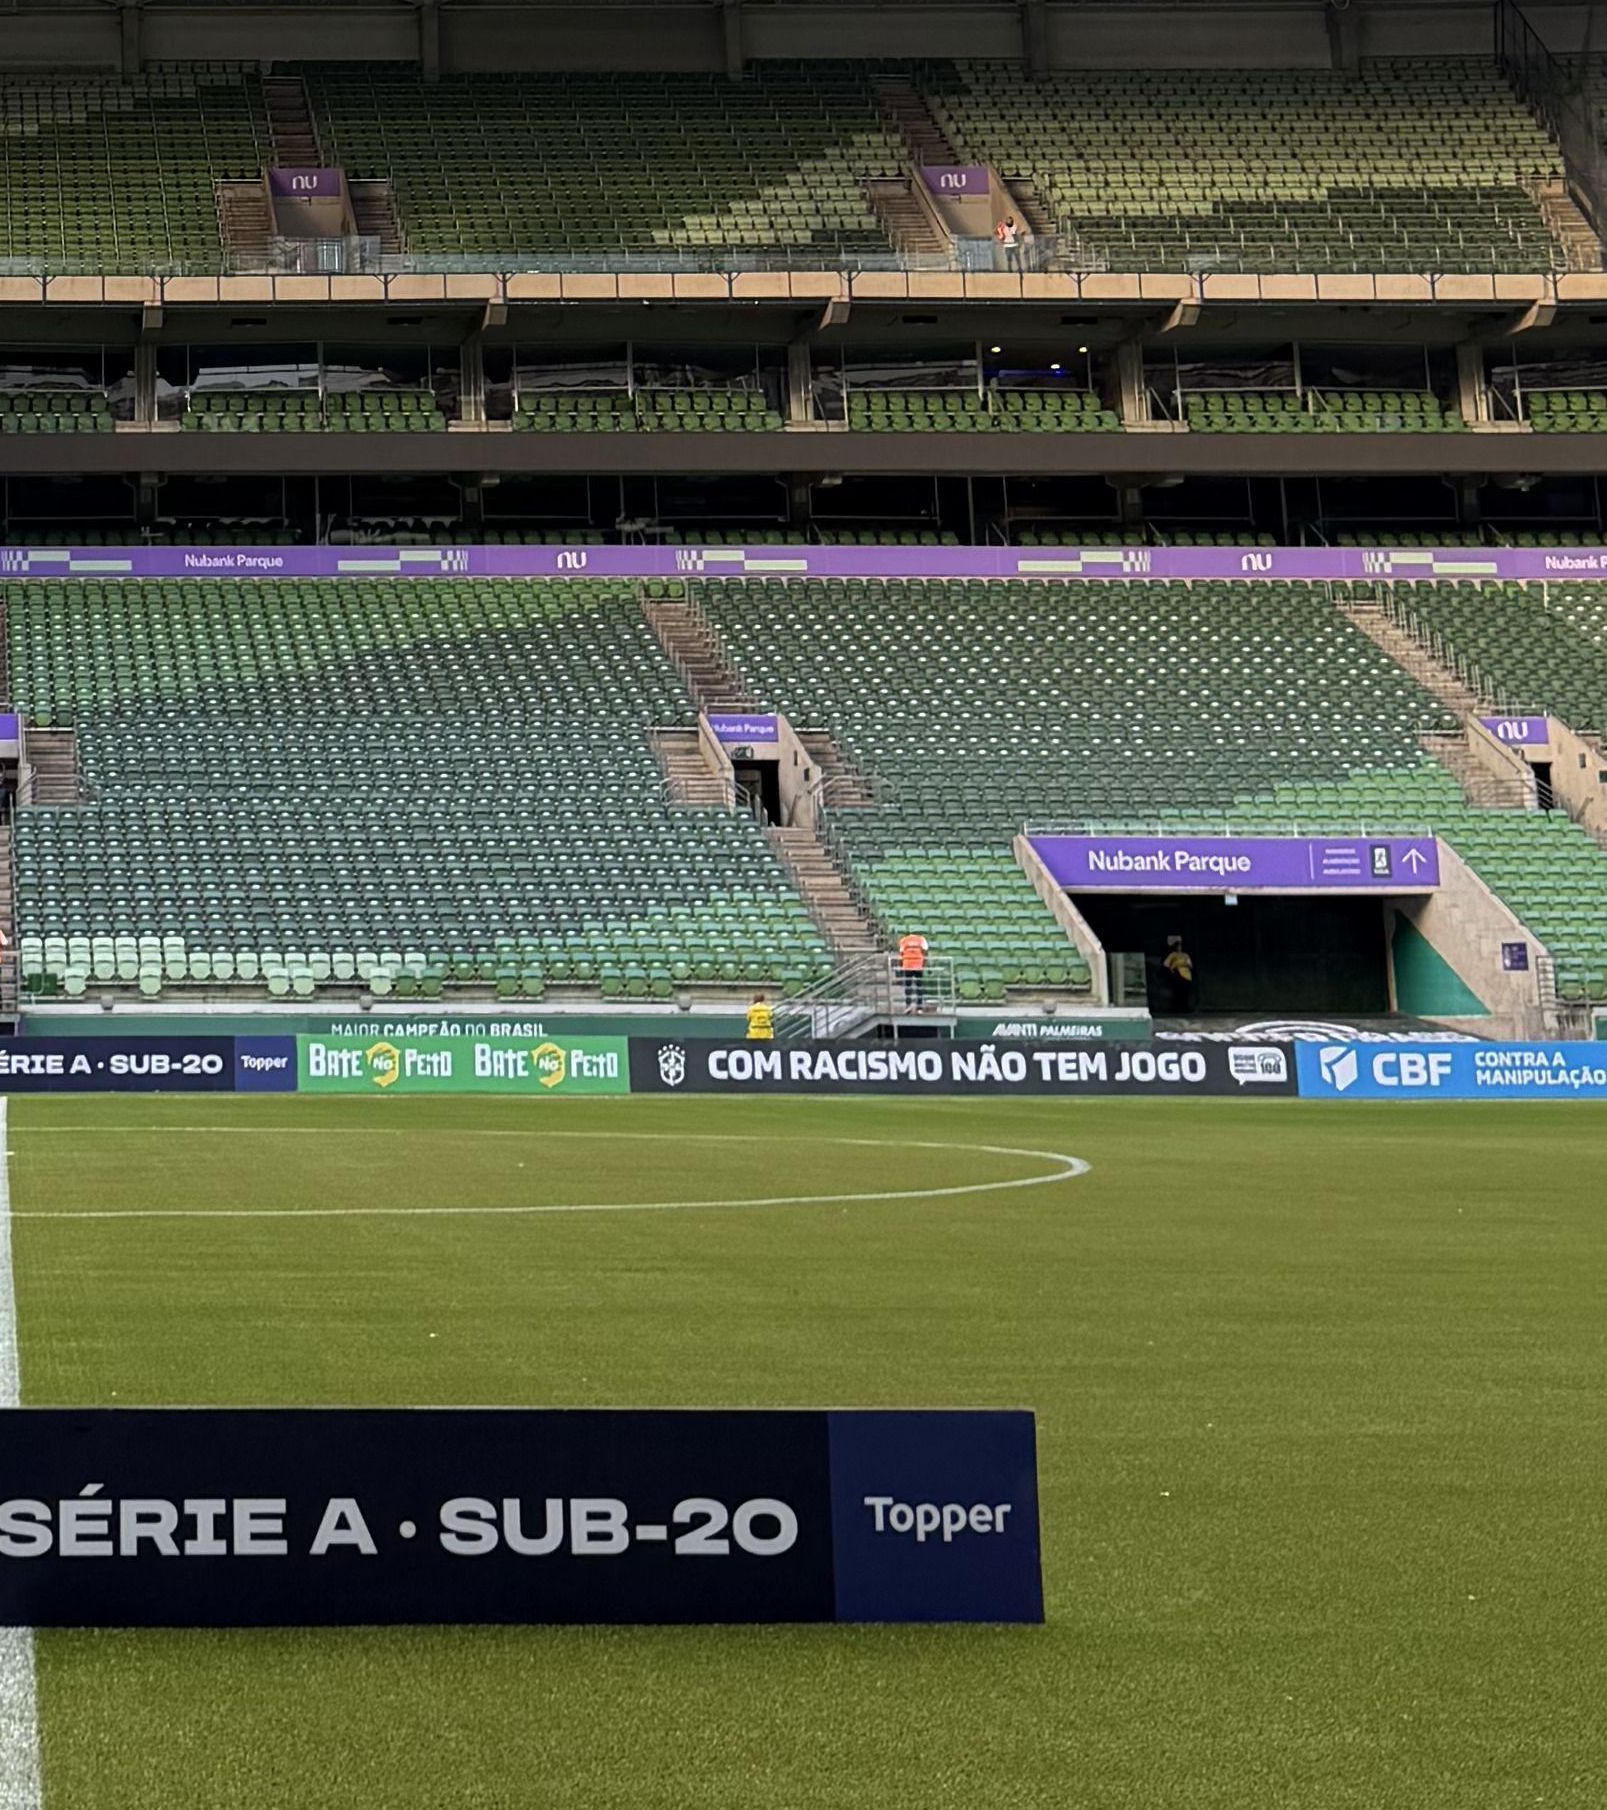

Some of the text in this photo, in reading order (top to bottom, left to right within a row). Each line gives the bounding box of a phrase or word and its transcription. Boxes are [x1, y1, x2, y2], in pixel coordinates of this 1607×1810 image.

[185, 554, 283, 569] Nubank Parque
[1546, 556, 1598, 569] Nubank
[1089, 850, 1251, 876] Nubank Parque
[490, 1023, 548, 1037] BRASIL
[69, 1055, 92, 1074] A
[110, 1055, 222, 1074] SUB-20
[241, 1056, 288, 1071] Topper
[708, 1050, 782, 1080] COM
[790, 1051, 942, 1081] RACISMO
[951, 1044, 1026, 1081] NÃO
[1033, 1052, 1107, 1080] TEM
[1115, 1052, 1206, 1081] JOGO
[1373, 1053, 1451, 1085] CBF
[1475, 1052, 1565, 1067] CONTRA A
[1476, 1066, 1607, 1089] MANIPULAÇÃO
[310, 1498, 377, 1554] A
[440, 1498, 798, 1555] SUB-20
[864, 1497, 1011, 1542] Topper
